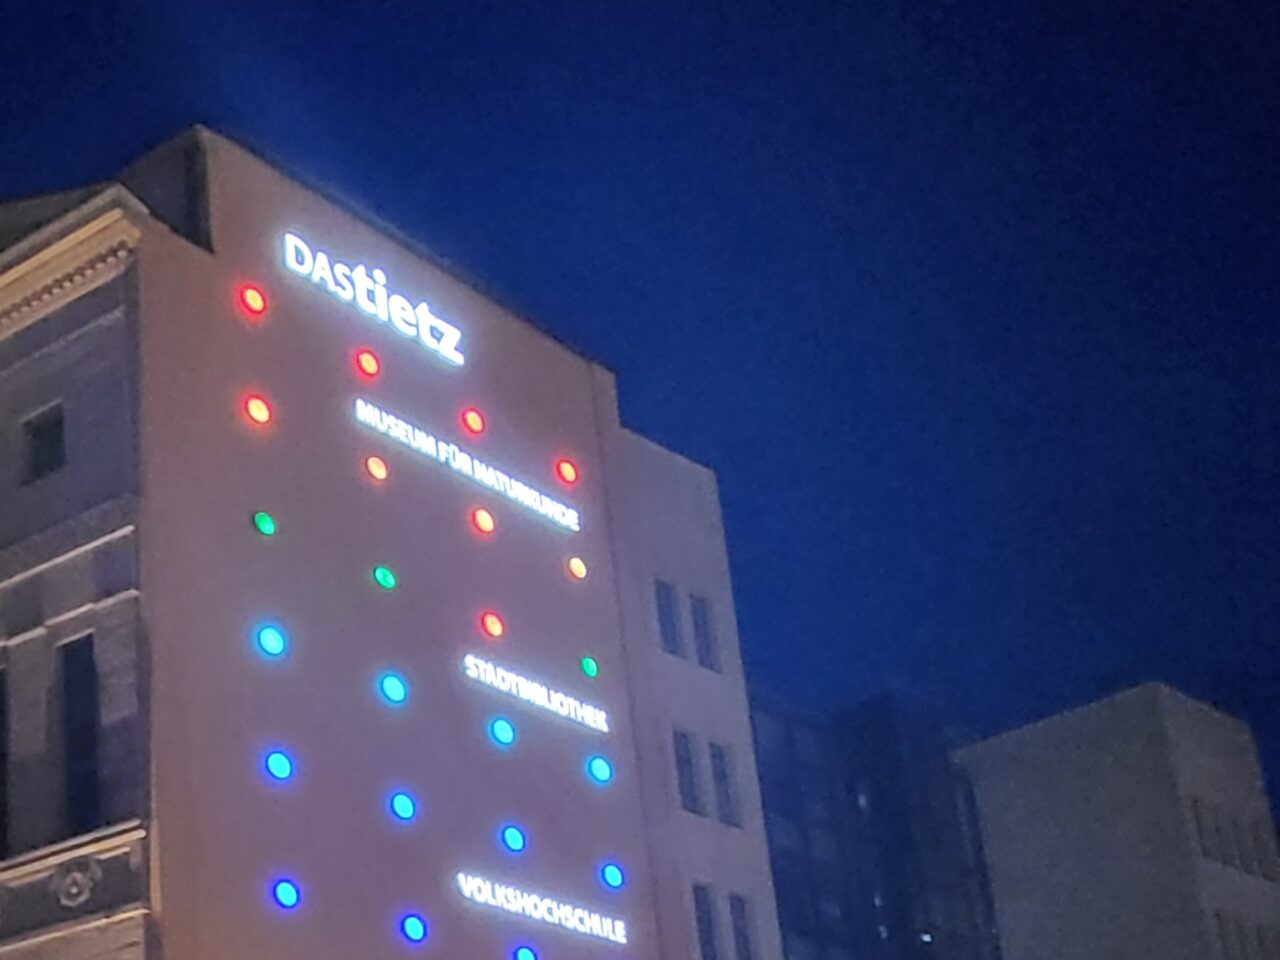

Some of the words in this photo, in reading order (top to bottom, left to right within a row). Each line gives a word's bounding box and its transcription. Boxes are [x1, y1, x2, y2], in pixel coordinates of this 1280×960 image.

[356, 398, 437, 459] MUSEUM
[438, 442, 473, 475] FÜR
[475, 460, 581, 532] NATURKUNDE
[464, 654, 609, 732] STADTBIBLIOTHEK
[457, 872, 627, 943] VOLKSHOCHSCHULE
